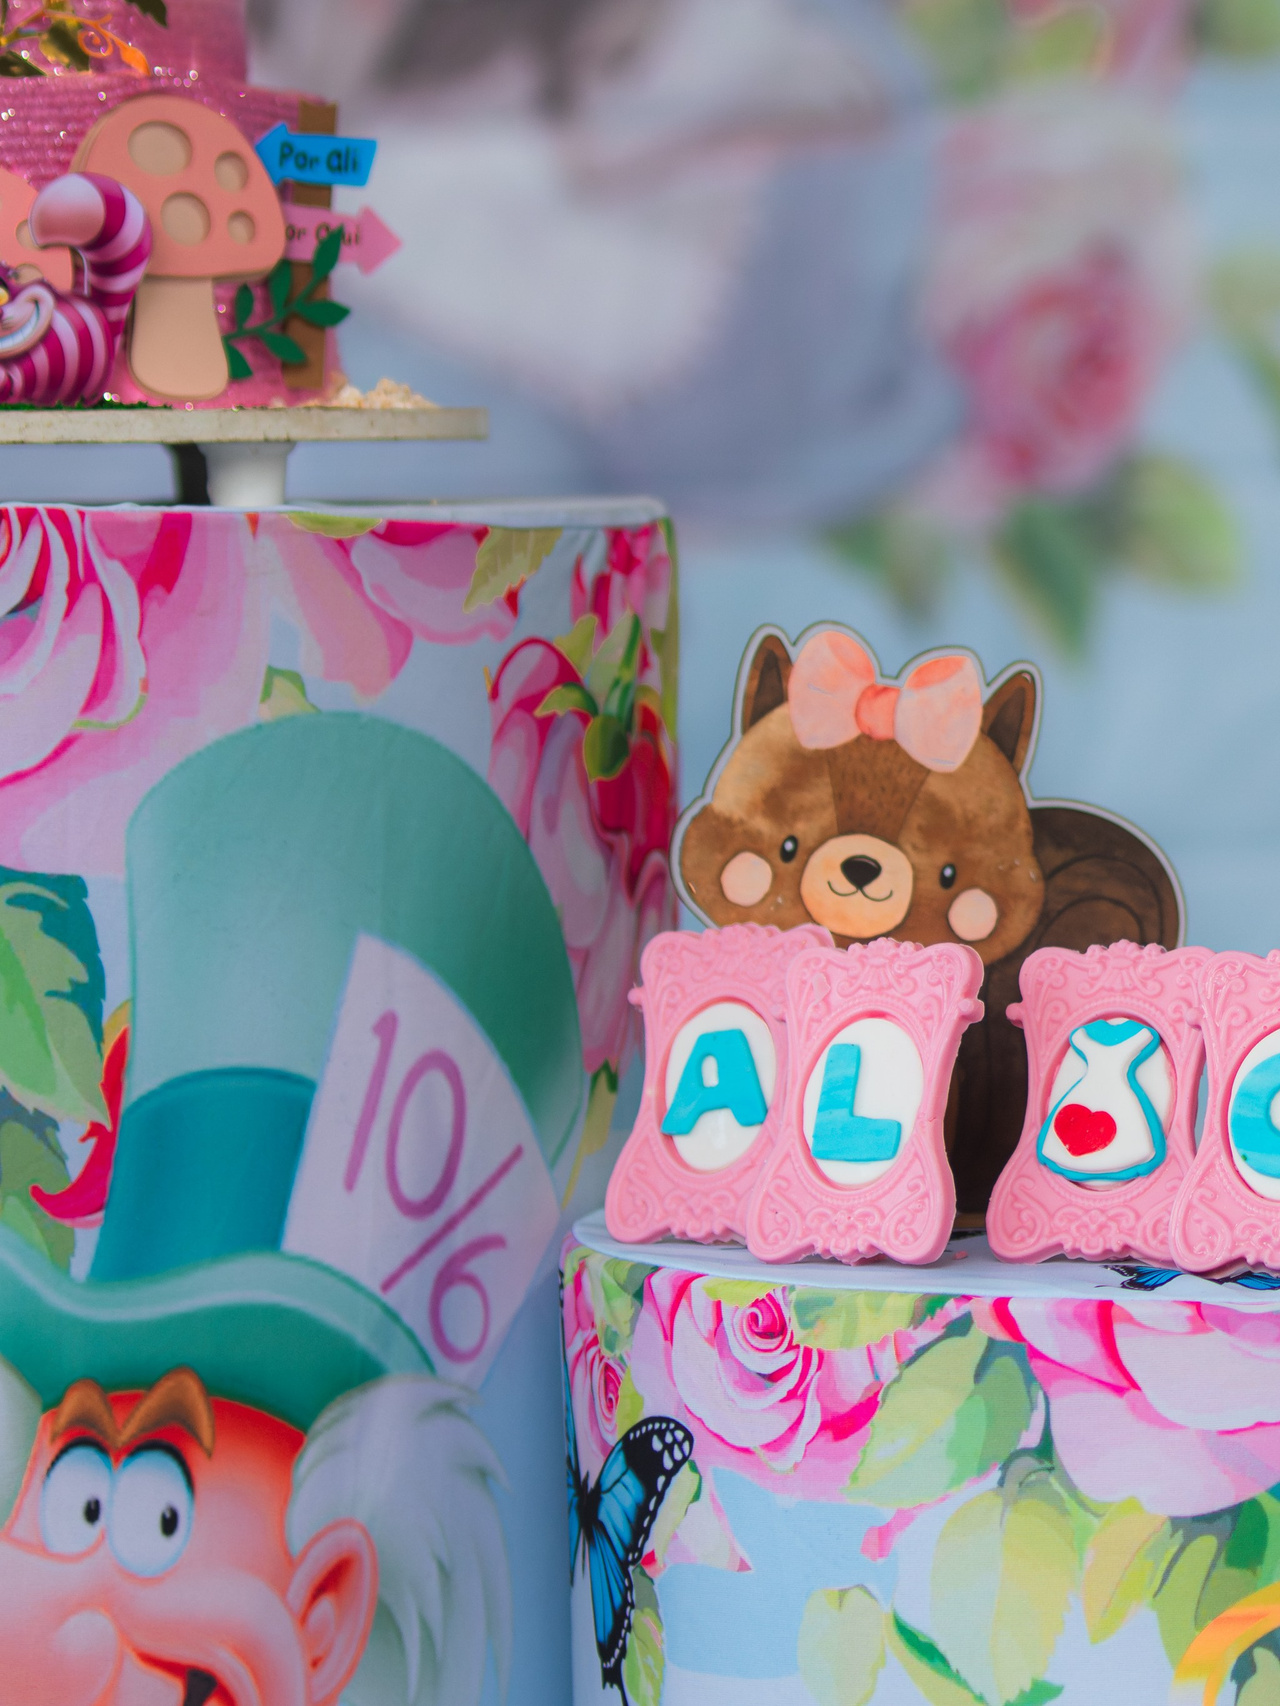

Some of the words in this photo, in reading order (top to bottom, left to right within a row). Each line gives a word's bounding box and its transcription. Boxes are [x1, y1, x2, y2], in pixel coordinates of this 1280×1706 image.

[279, 141, 319, 171] Por
[284, 224, 306, 241] or
[316, 222, 359, 246] aui
